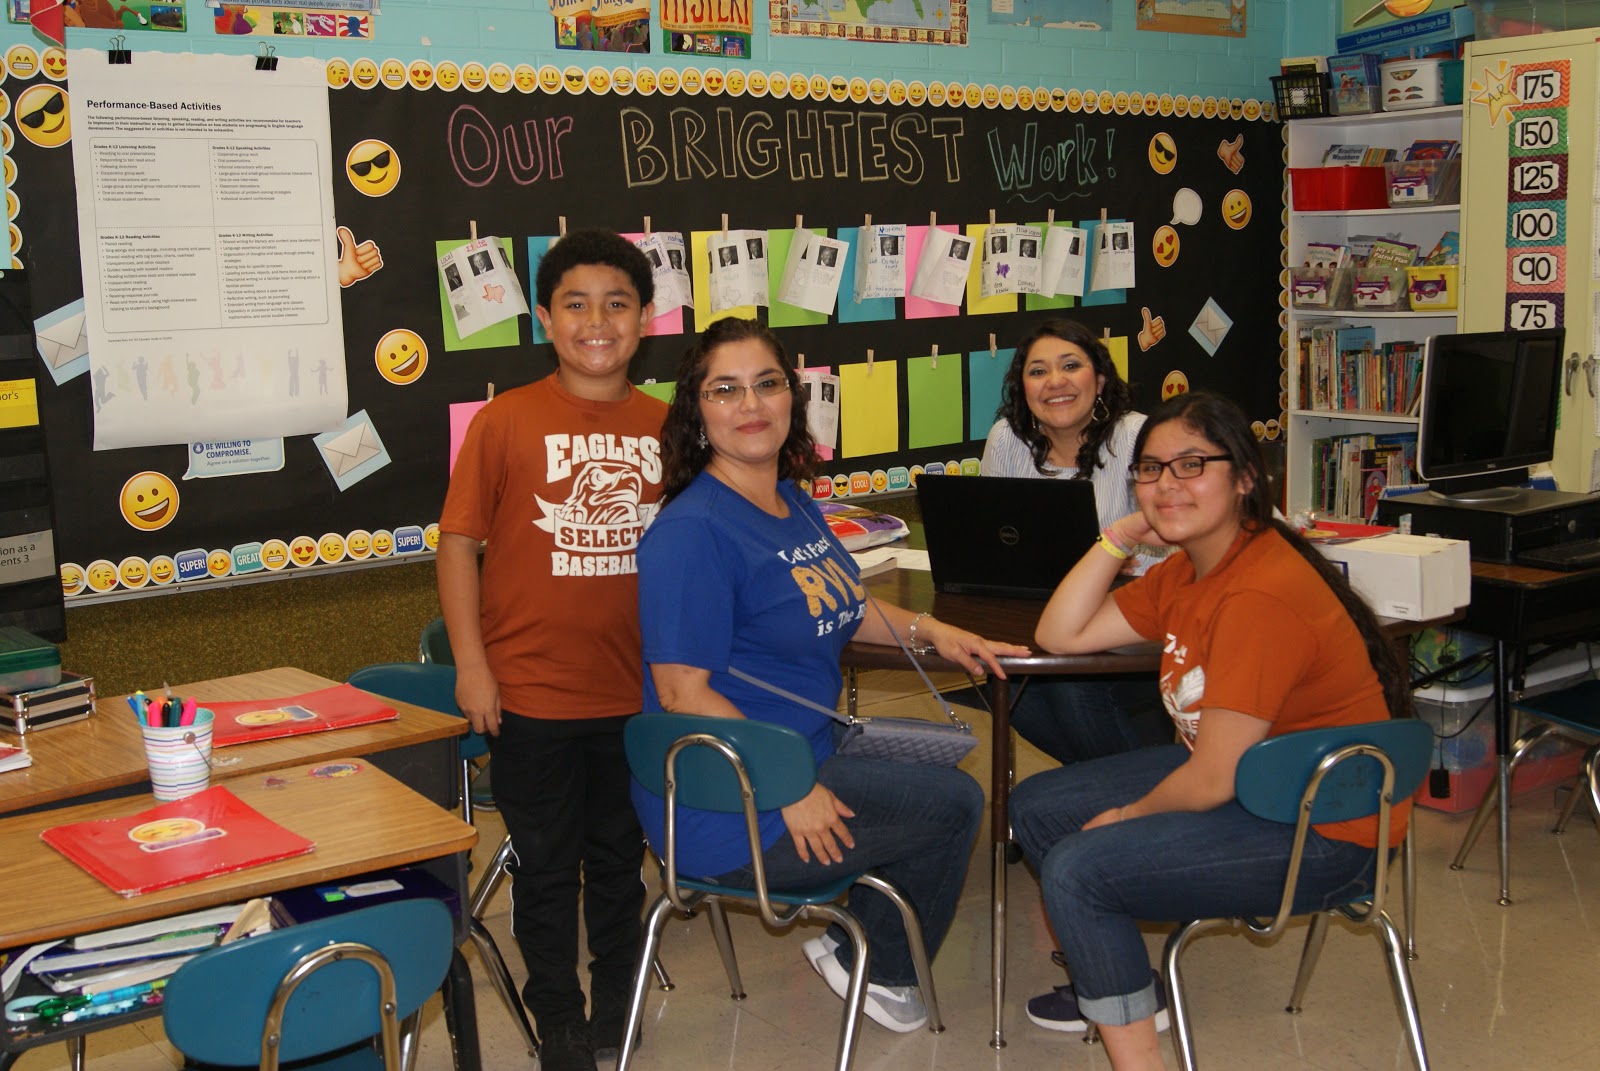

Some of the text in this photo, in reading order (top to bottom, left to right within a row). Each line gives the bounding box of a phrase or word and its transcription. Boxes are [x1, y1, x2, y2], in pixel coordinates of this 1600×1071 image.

[1487, 83, 1510, 104] A.R.
[1524, 74, 1554, 100] 175
[87, 100, 221, 111] Performance-Based Activities
[1520, 120, 1553, 146] 150
[446, 104, 1116, 191] Our BRIGHTEST Work!
[1520, 165, 1553, 190] 125
[1516, 212, 1553, 238] 100
[1519, 256, 1550, 281] 90
[1520, 304, 1547, 328] 75
[206, 448, 252, 458] COMPROMISE.
[215, 441, 241, 449] WILLING
[544, 433, 663, 484] EAGLES
[965, 465, 977, 474] NICE!
[853, 480, 868, 489] COOL!
[891, 475, 907, 484] GREAT!
[398, 536, 421, 547] SUPER!
[560, 525, 644, 548] SELECT
[180, 556, 206, 572] SUPER!
[551, 551, 638, 577] BASEBAL
[817, 620, 833, 636] is
[838, 610, 854, 629] The
